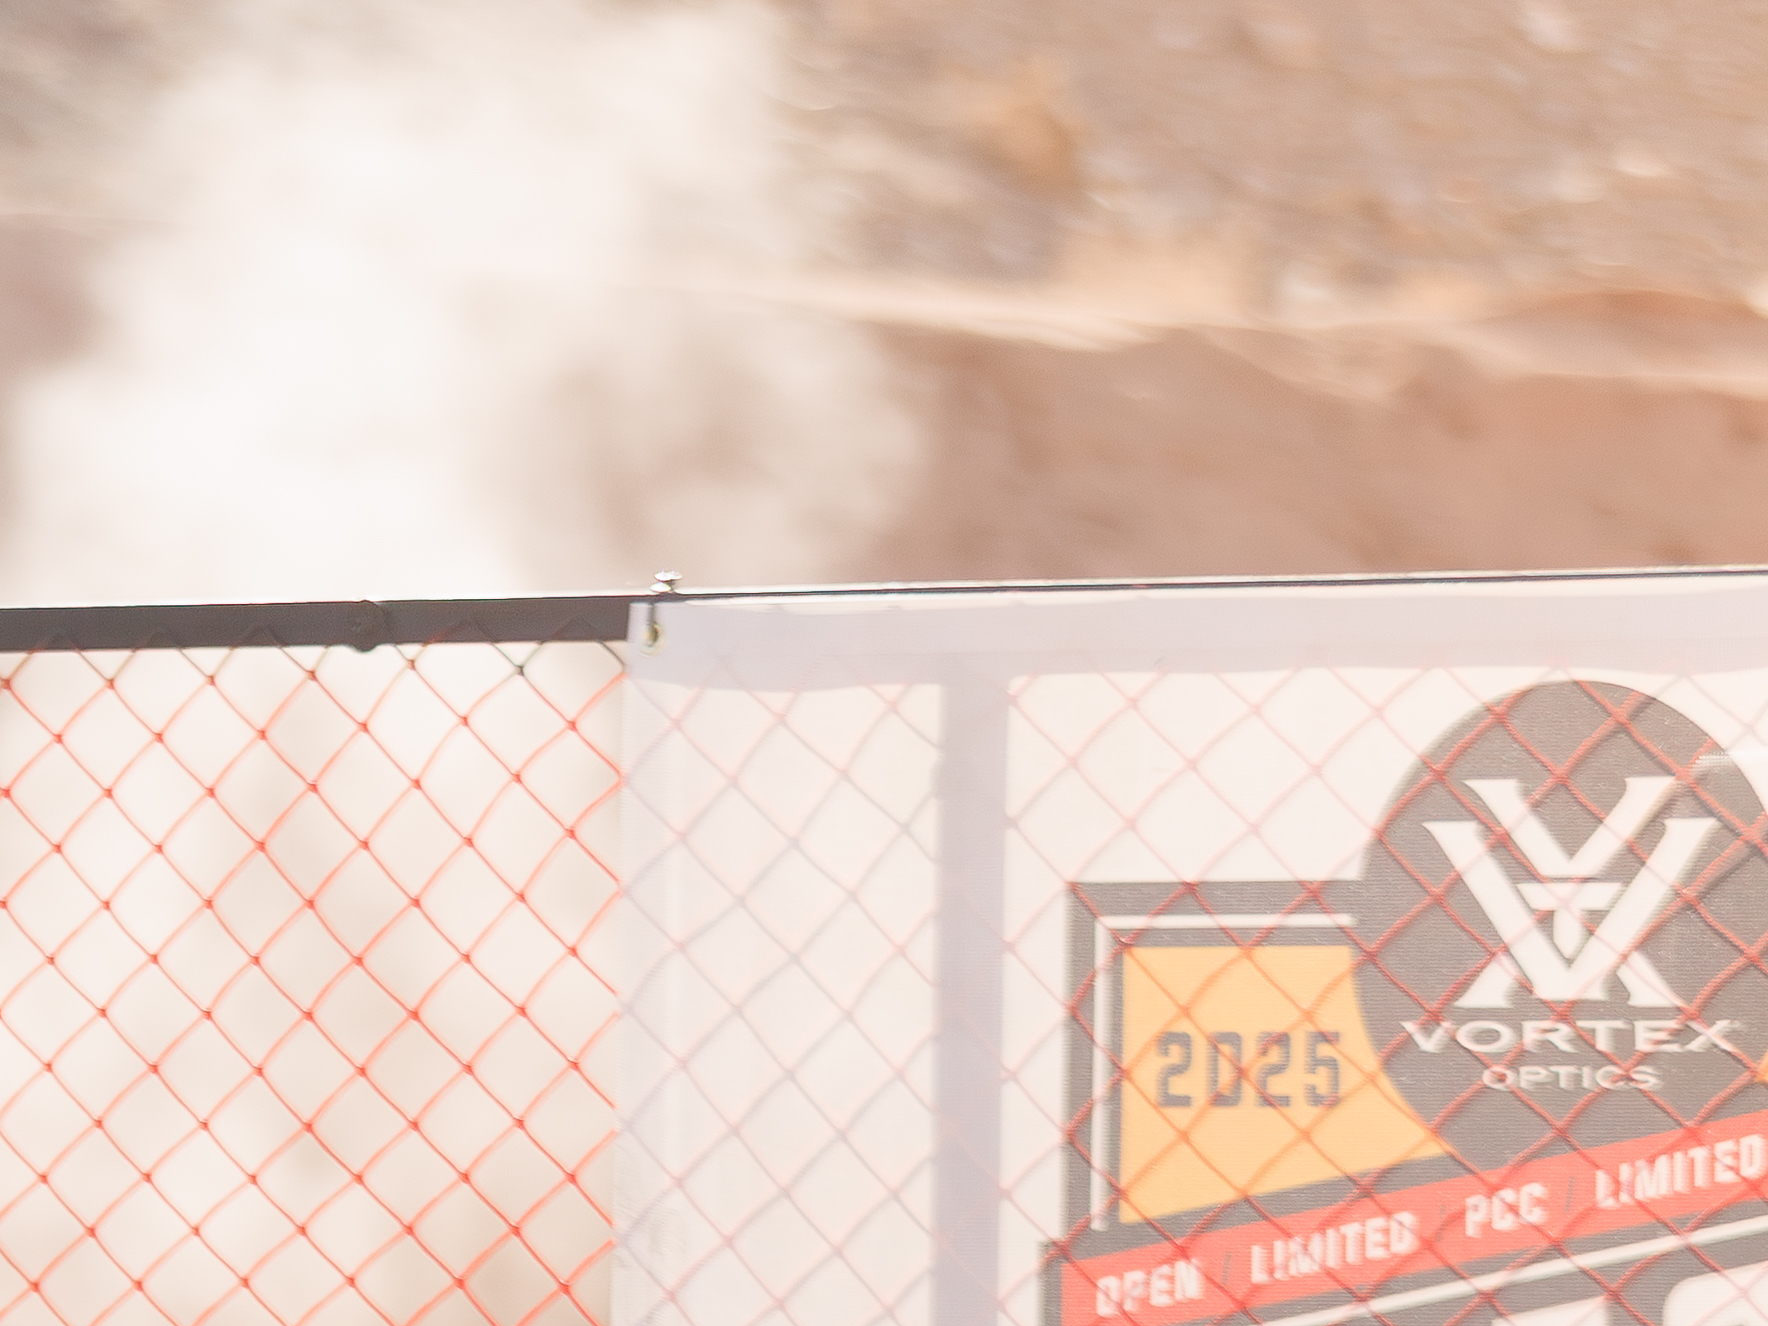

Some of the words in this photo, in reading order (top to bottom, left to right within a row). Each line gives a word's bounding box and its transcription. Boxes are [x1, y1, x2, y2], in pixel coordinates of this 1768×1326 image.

[1399, 1018, 1742, 1054] VORTEX
[1156, 1030, 1343, 1110] 2025
[1482, 1064, 1663, 1092] OPTICS
[1095, 1258, 1205, 1319] OPEN
[1250, 1210, 1422, 1286] LIMITED
[1465, 1181, 1550, 1239] PCC
[1594, 1132, 1765, 1211] LIMITED
